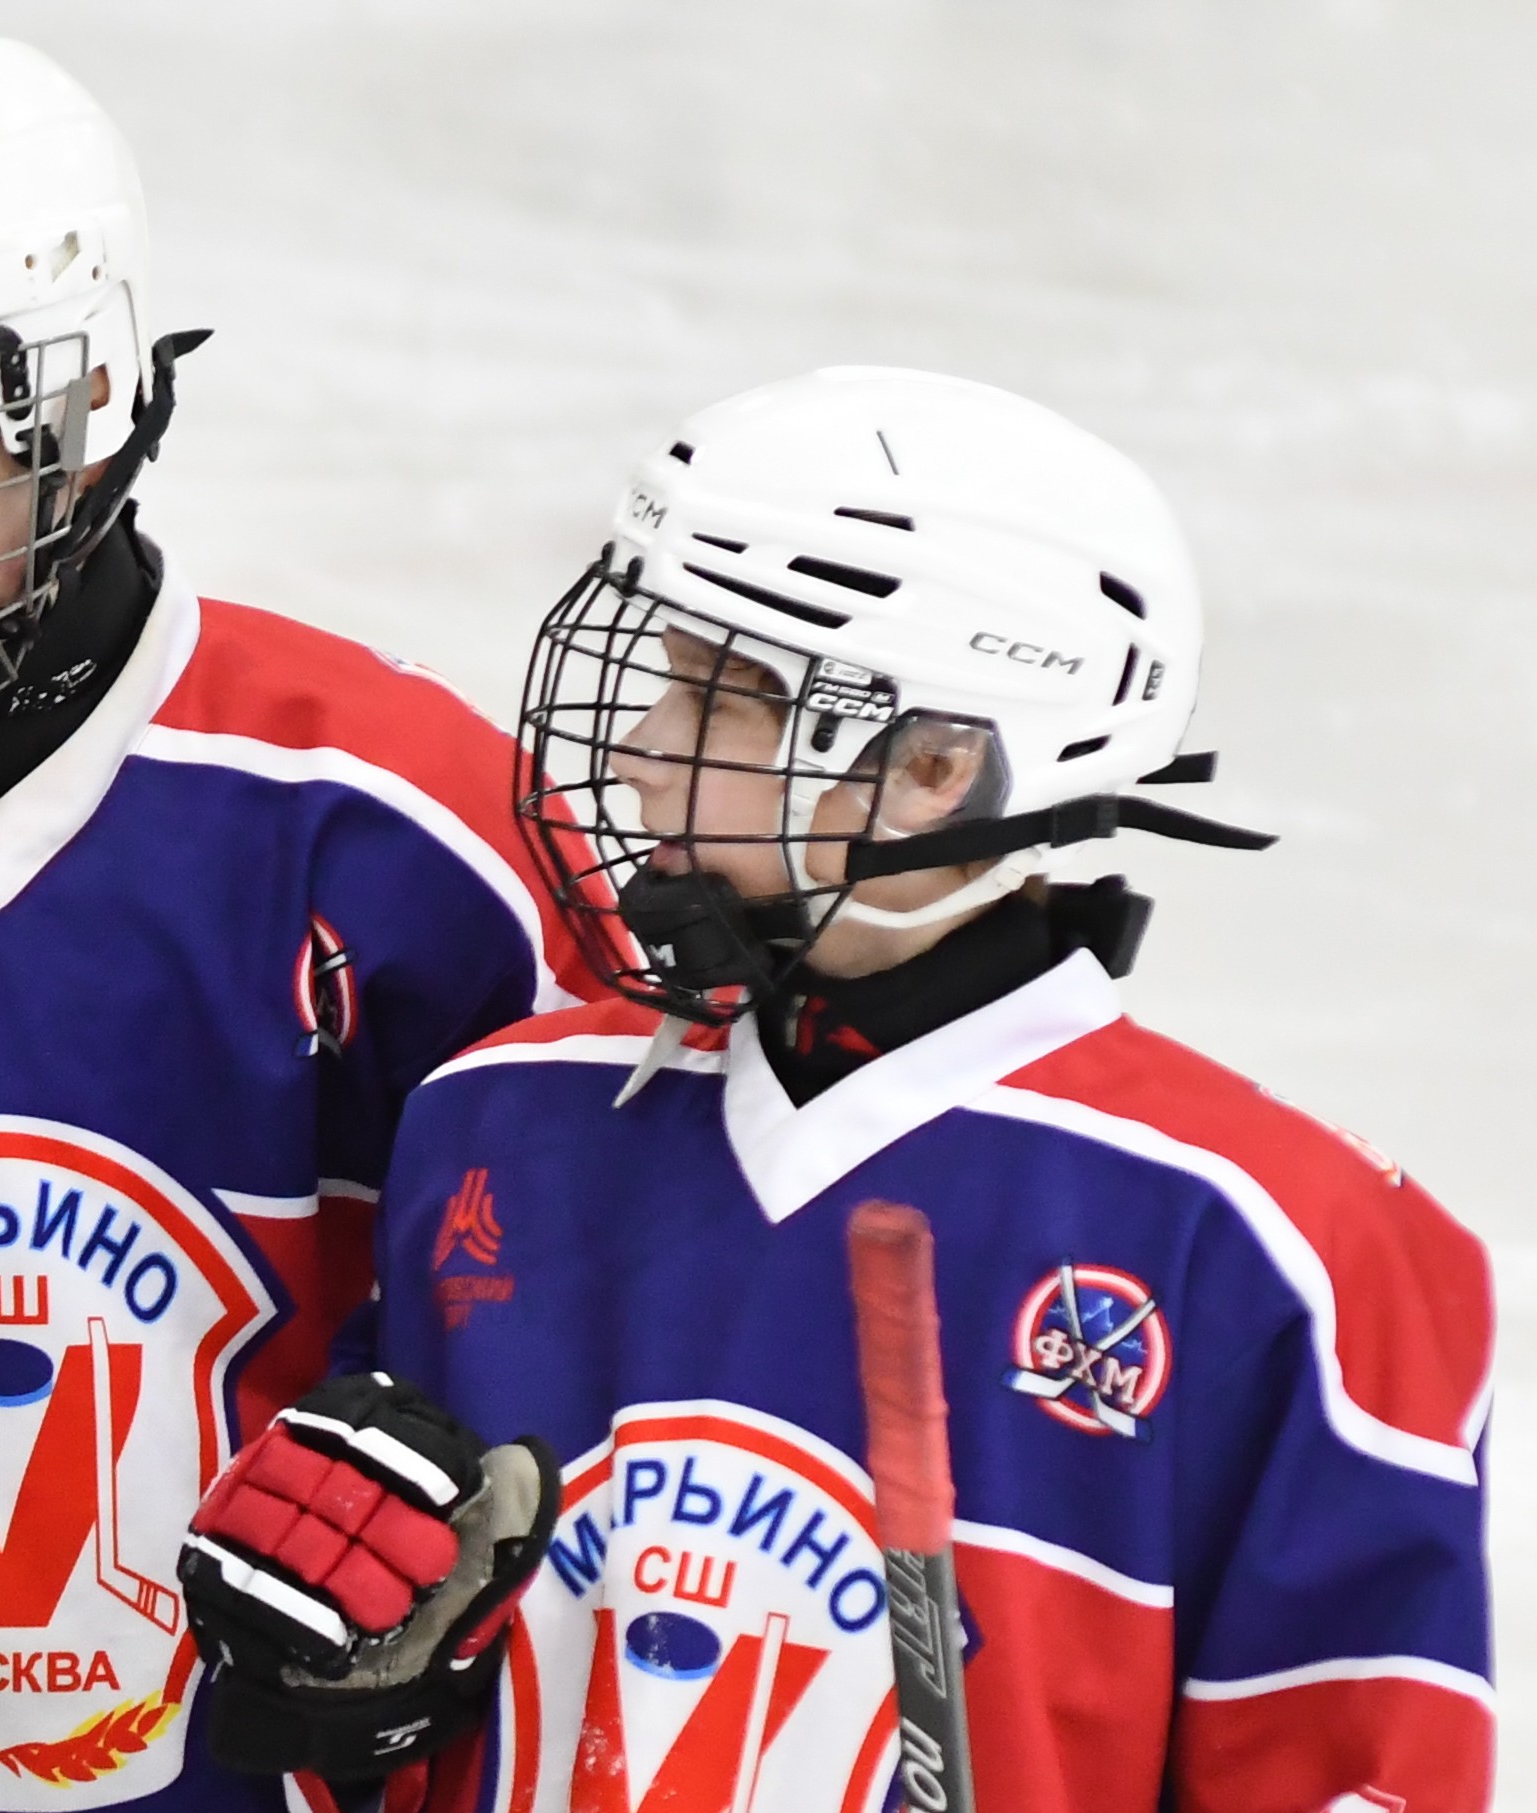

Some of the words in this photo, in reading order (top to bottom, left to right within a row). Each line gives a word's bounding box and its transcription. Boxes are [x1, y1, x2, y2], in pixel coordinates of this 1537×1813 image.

[969, 630, 1084, 676] CCM
[807, 693, 894, 723] CCM
[1032, 1329, 1144, 1404] ФХМ
[546, 1455, 888, 1634] МРЬИНО
[633, 1545, 737, 1609] СШ
